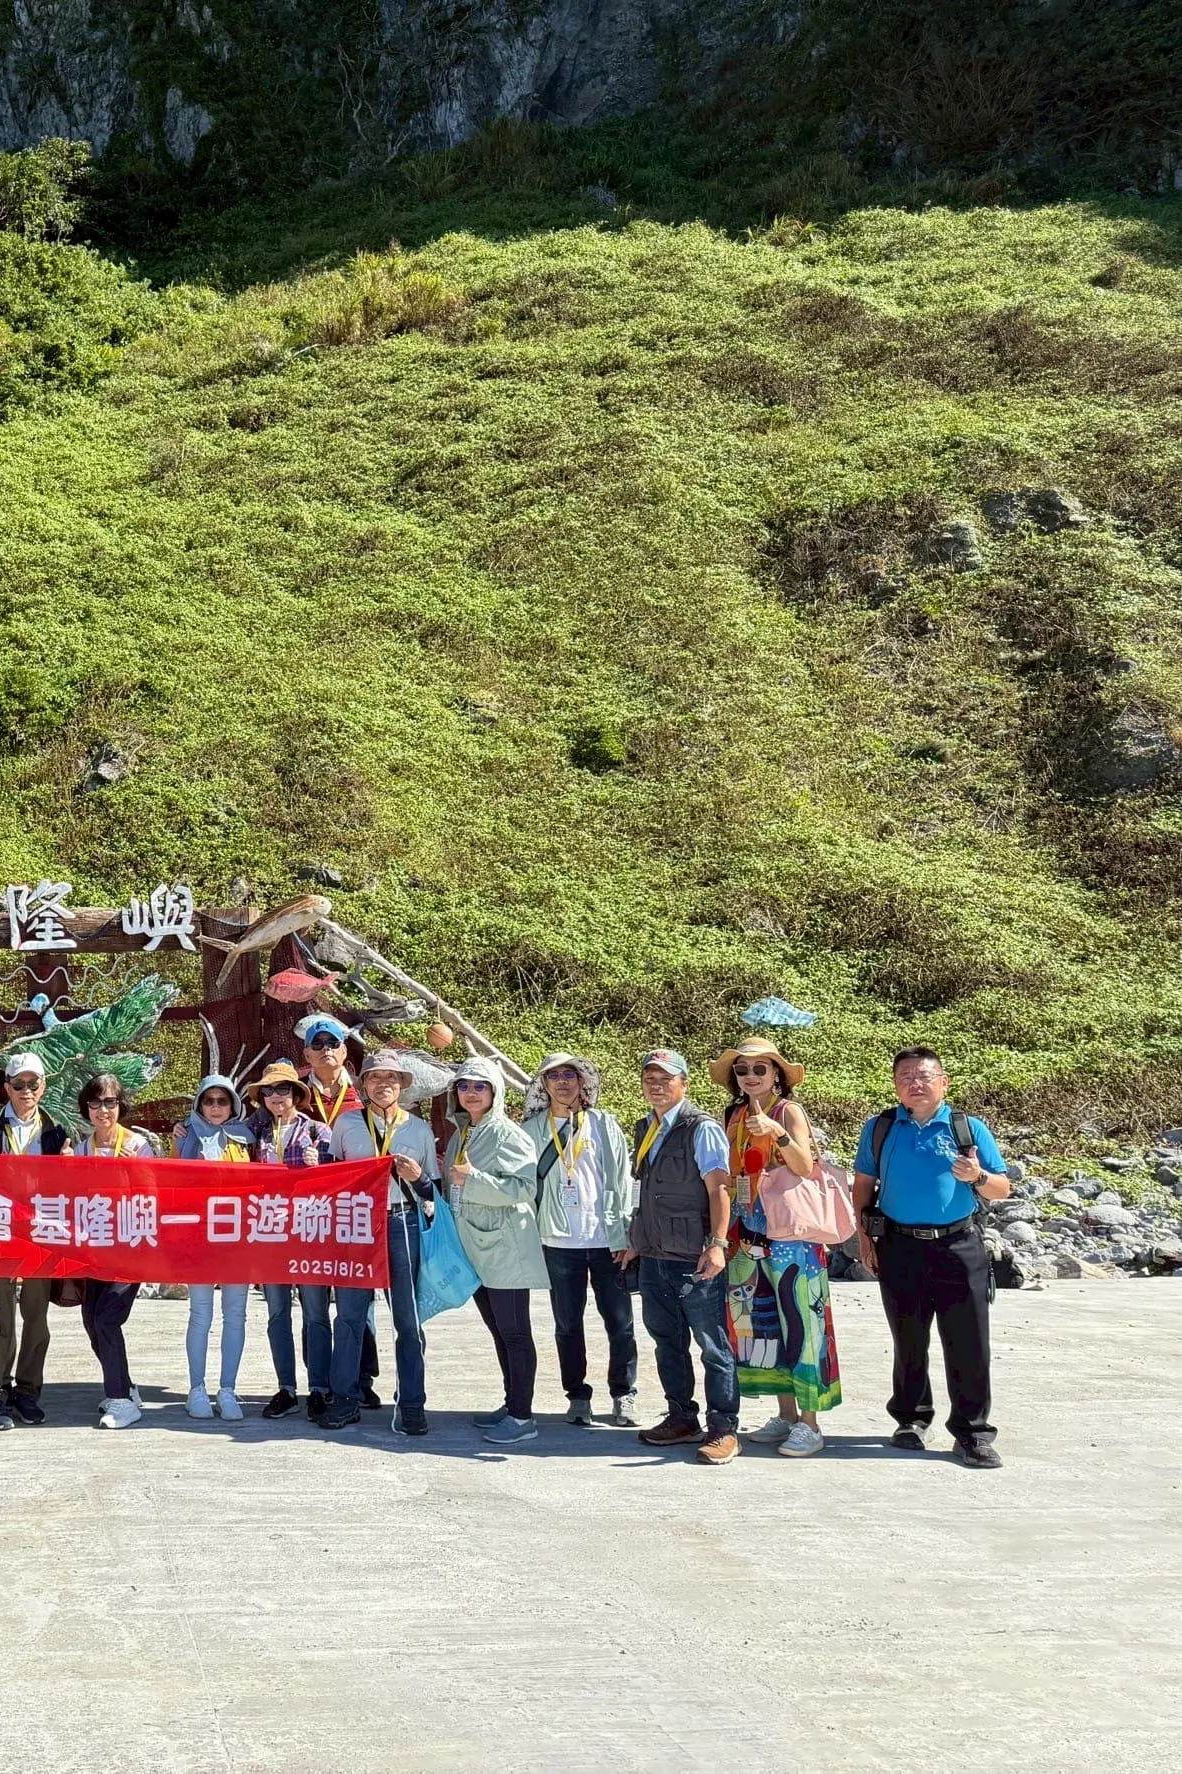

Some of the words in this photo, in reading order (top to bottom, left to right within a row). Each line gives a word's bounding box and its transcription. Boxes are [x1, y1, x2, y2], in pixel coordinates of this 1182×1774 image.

[30, 1191, 374, 1247] 基隆嶼一日遊聯誼
[288, 1259, 374, 1279] 2025/8/21
